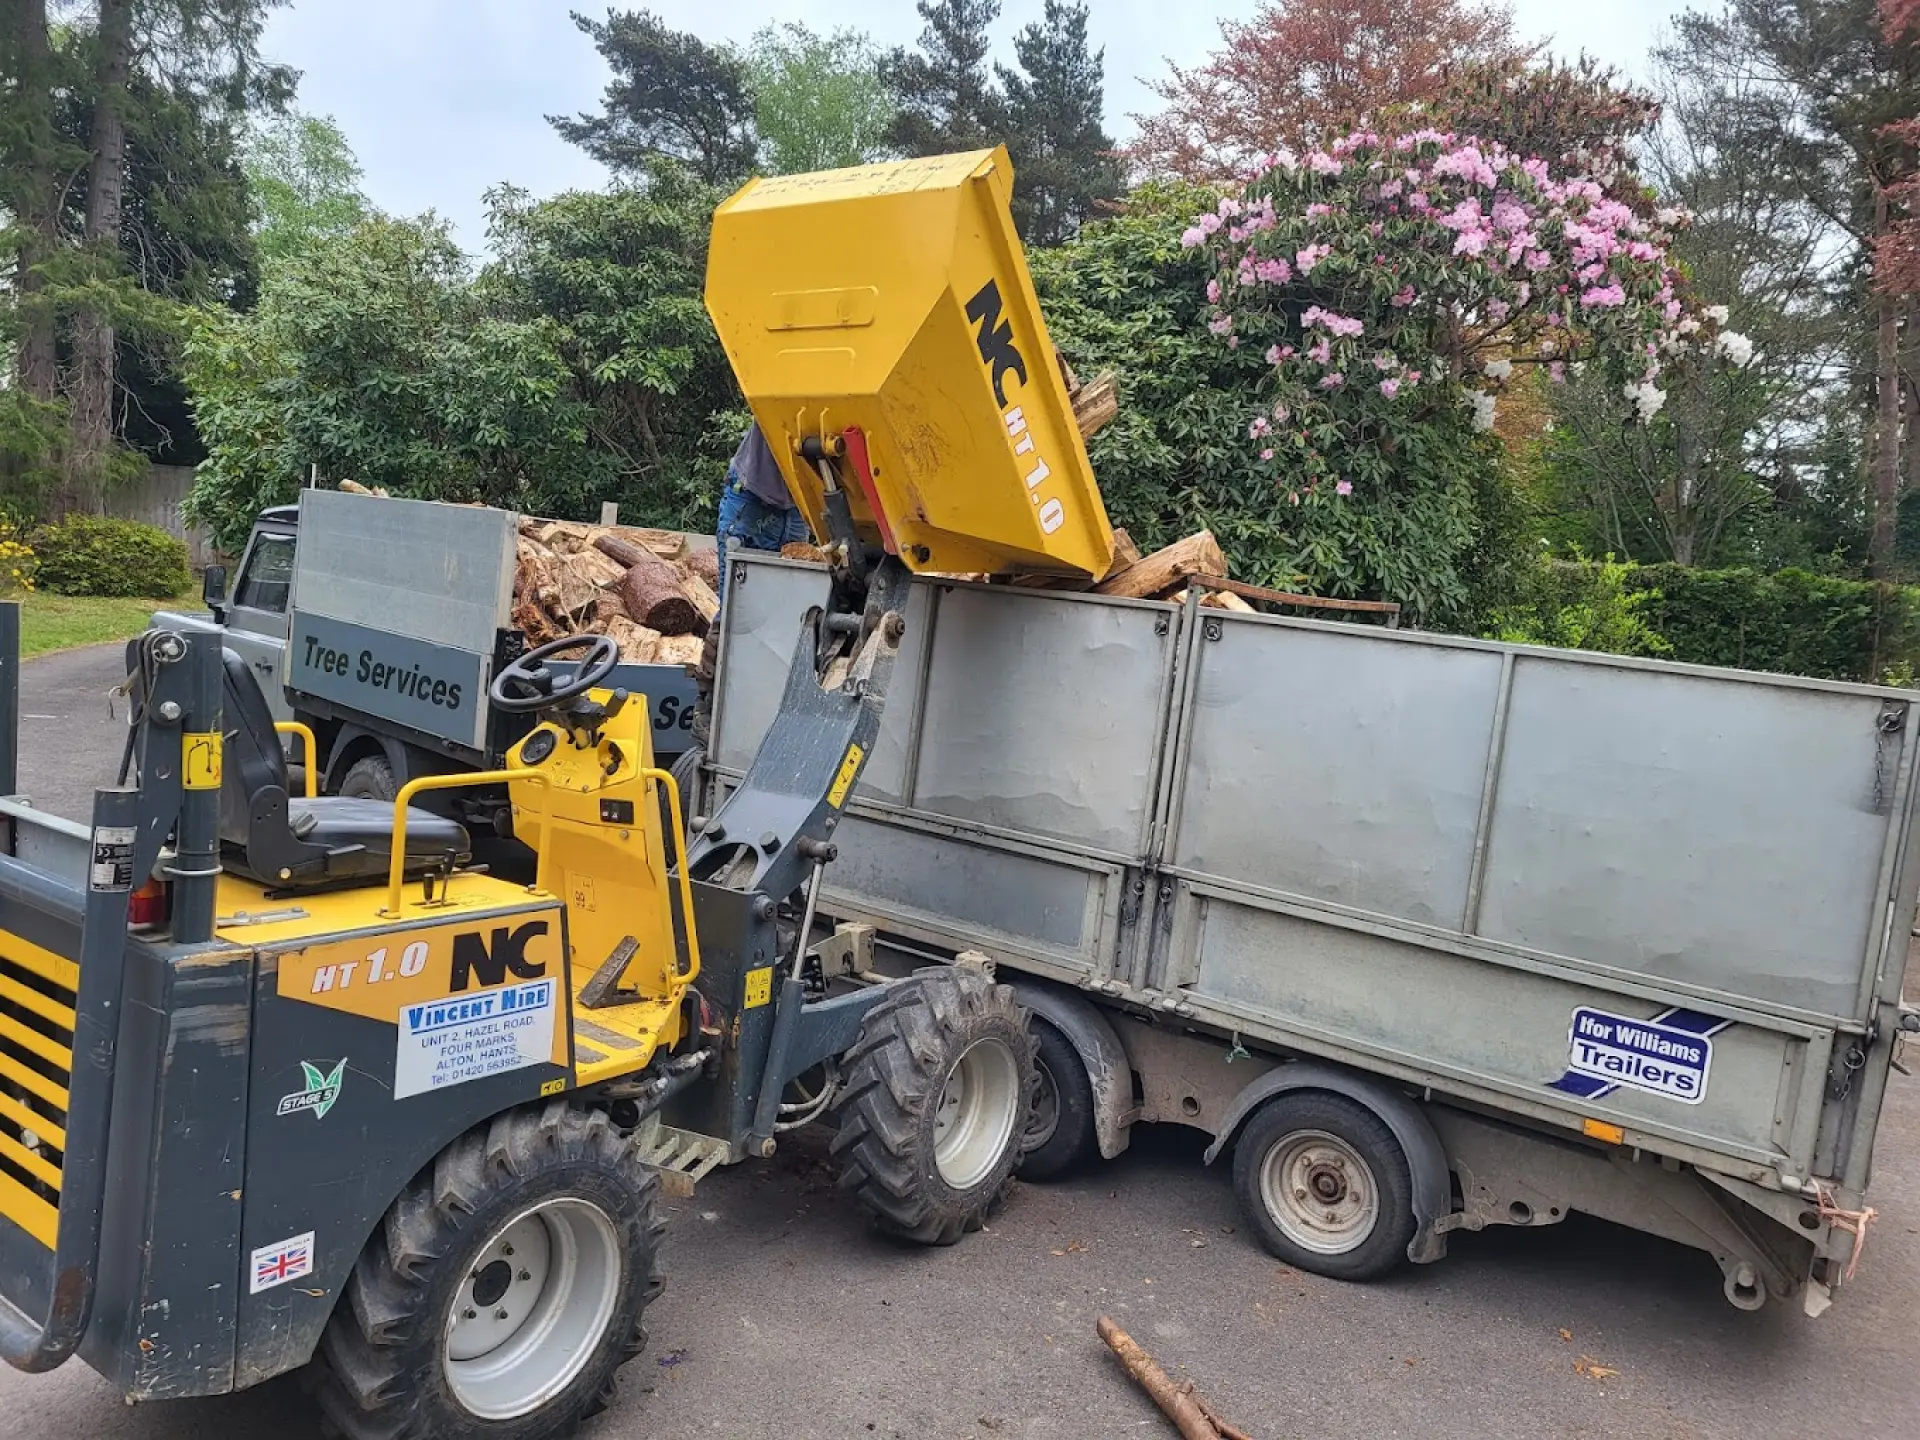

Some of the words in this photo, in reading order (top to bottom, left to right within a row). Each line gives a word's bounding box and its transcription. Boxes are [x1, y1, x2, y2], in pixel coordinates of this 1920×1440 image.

[964, 277, 1028, 410] NC
[1004, 406, 1036, 457] HT
[1025, 456, 1065, 535] 1.0
[304, 635, 349, 677] Tree
[356, 650, 462, 711] Services
[311, 960, 360, 994] HT
[366, 940, 429, 985] 1.0
[449, 921, 549, 993] NC
[408, 1000, 494, 1030] VINCENT
[501, 987, 546, 1011] HIRE
[421, 1033, 448, 1048] UNIT
[465, 1023, 500, 1038] HAZEL
[440, 1041, 473, 1056] FOUR
[1579, 1015, 1613, 1040] Ifor
[1615, 1024, 1700, 1063] Williams
[431, 1073, 449, 1085] Tel:
[452, 1064, 483, 1080] 01420
[1577, 1041, 1695, 1091] Trailers
[282, 1091, 322, 1111] STAGE
